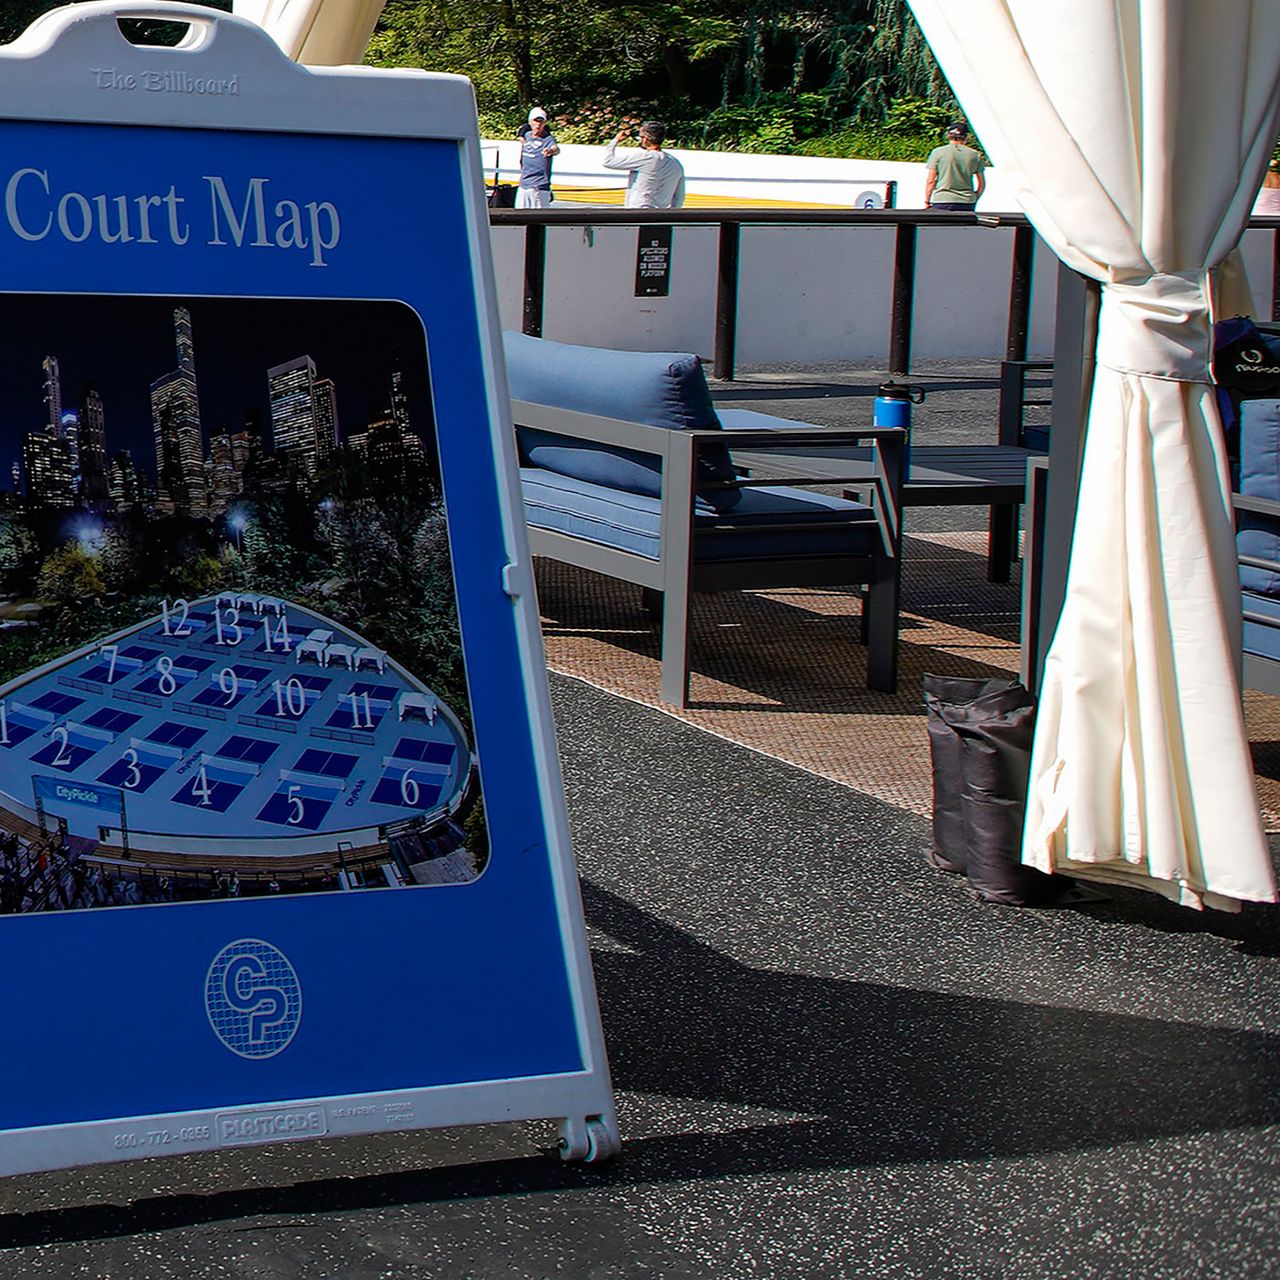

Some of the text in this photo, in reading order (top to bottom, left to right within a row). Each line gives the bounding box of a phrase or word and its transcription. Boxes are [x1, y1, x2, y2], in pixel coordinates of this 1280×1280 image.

[142, 70, 239, 96] Billboard
[5, 167, 341, 267] Court Map
[159, 599, 192, 636] 12
[212, 608, 242, 646] 13
[261, 616, 292, 653] 14
[98, 645, 118, 683] 7
[158, 656, 176, 695] 8
[219, 668, 238, 706] 9
[272, 678, 306, 716] 10
[348, 691, 375, 729] 11
[51, 726, 72, 766] 2
[122, 748, 140, 788] 3
[192, 767, 212, 805] 4
[400, 767, 420, 805] 6
[56, 784, 99, 803] CityPickle
[286, 785, 305, 823] 5
[222, 1111, 319, 1139] PLASTICADE
